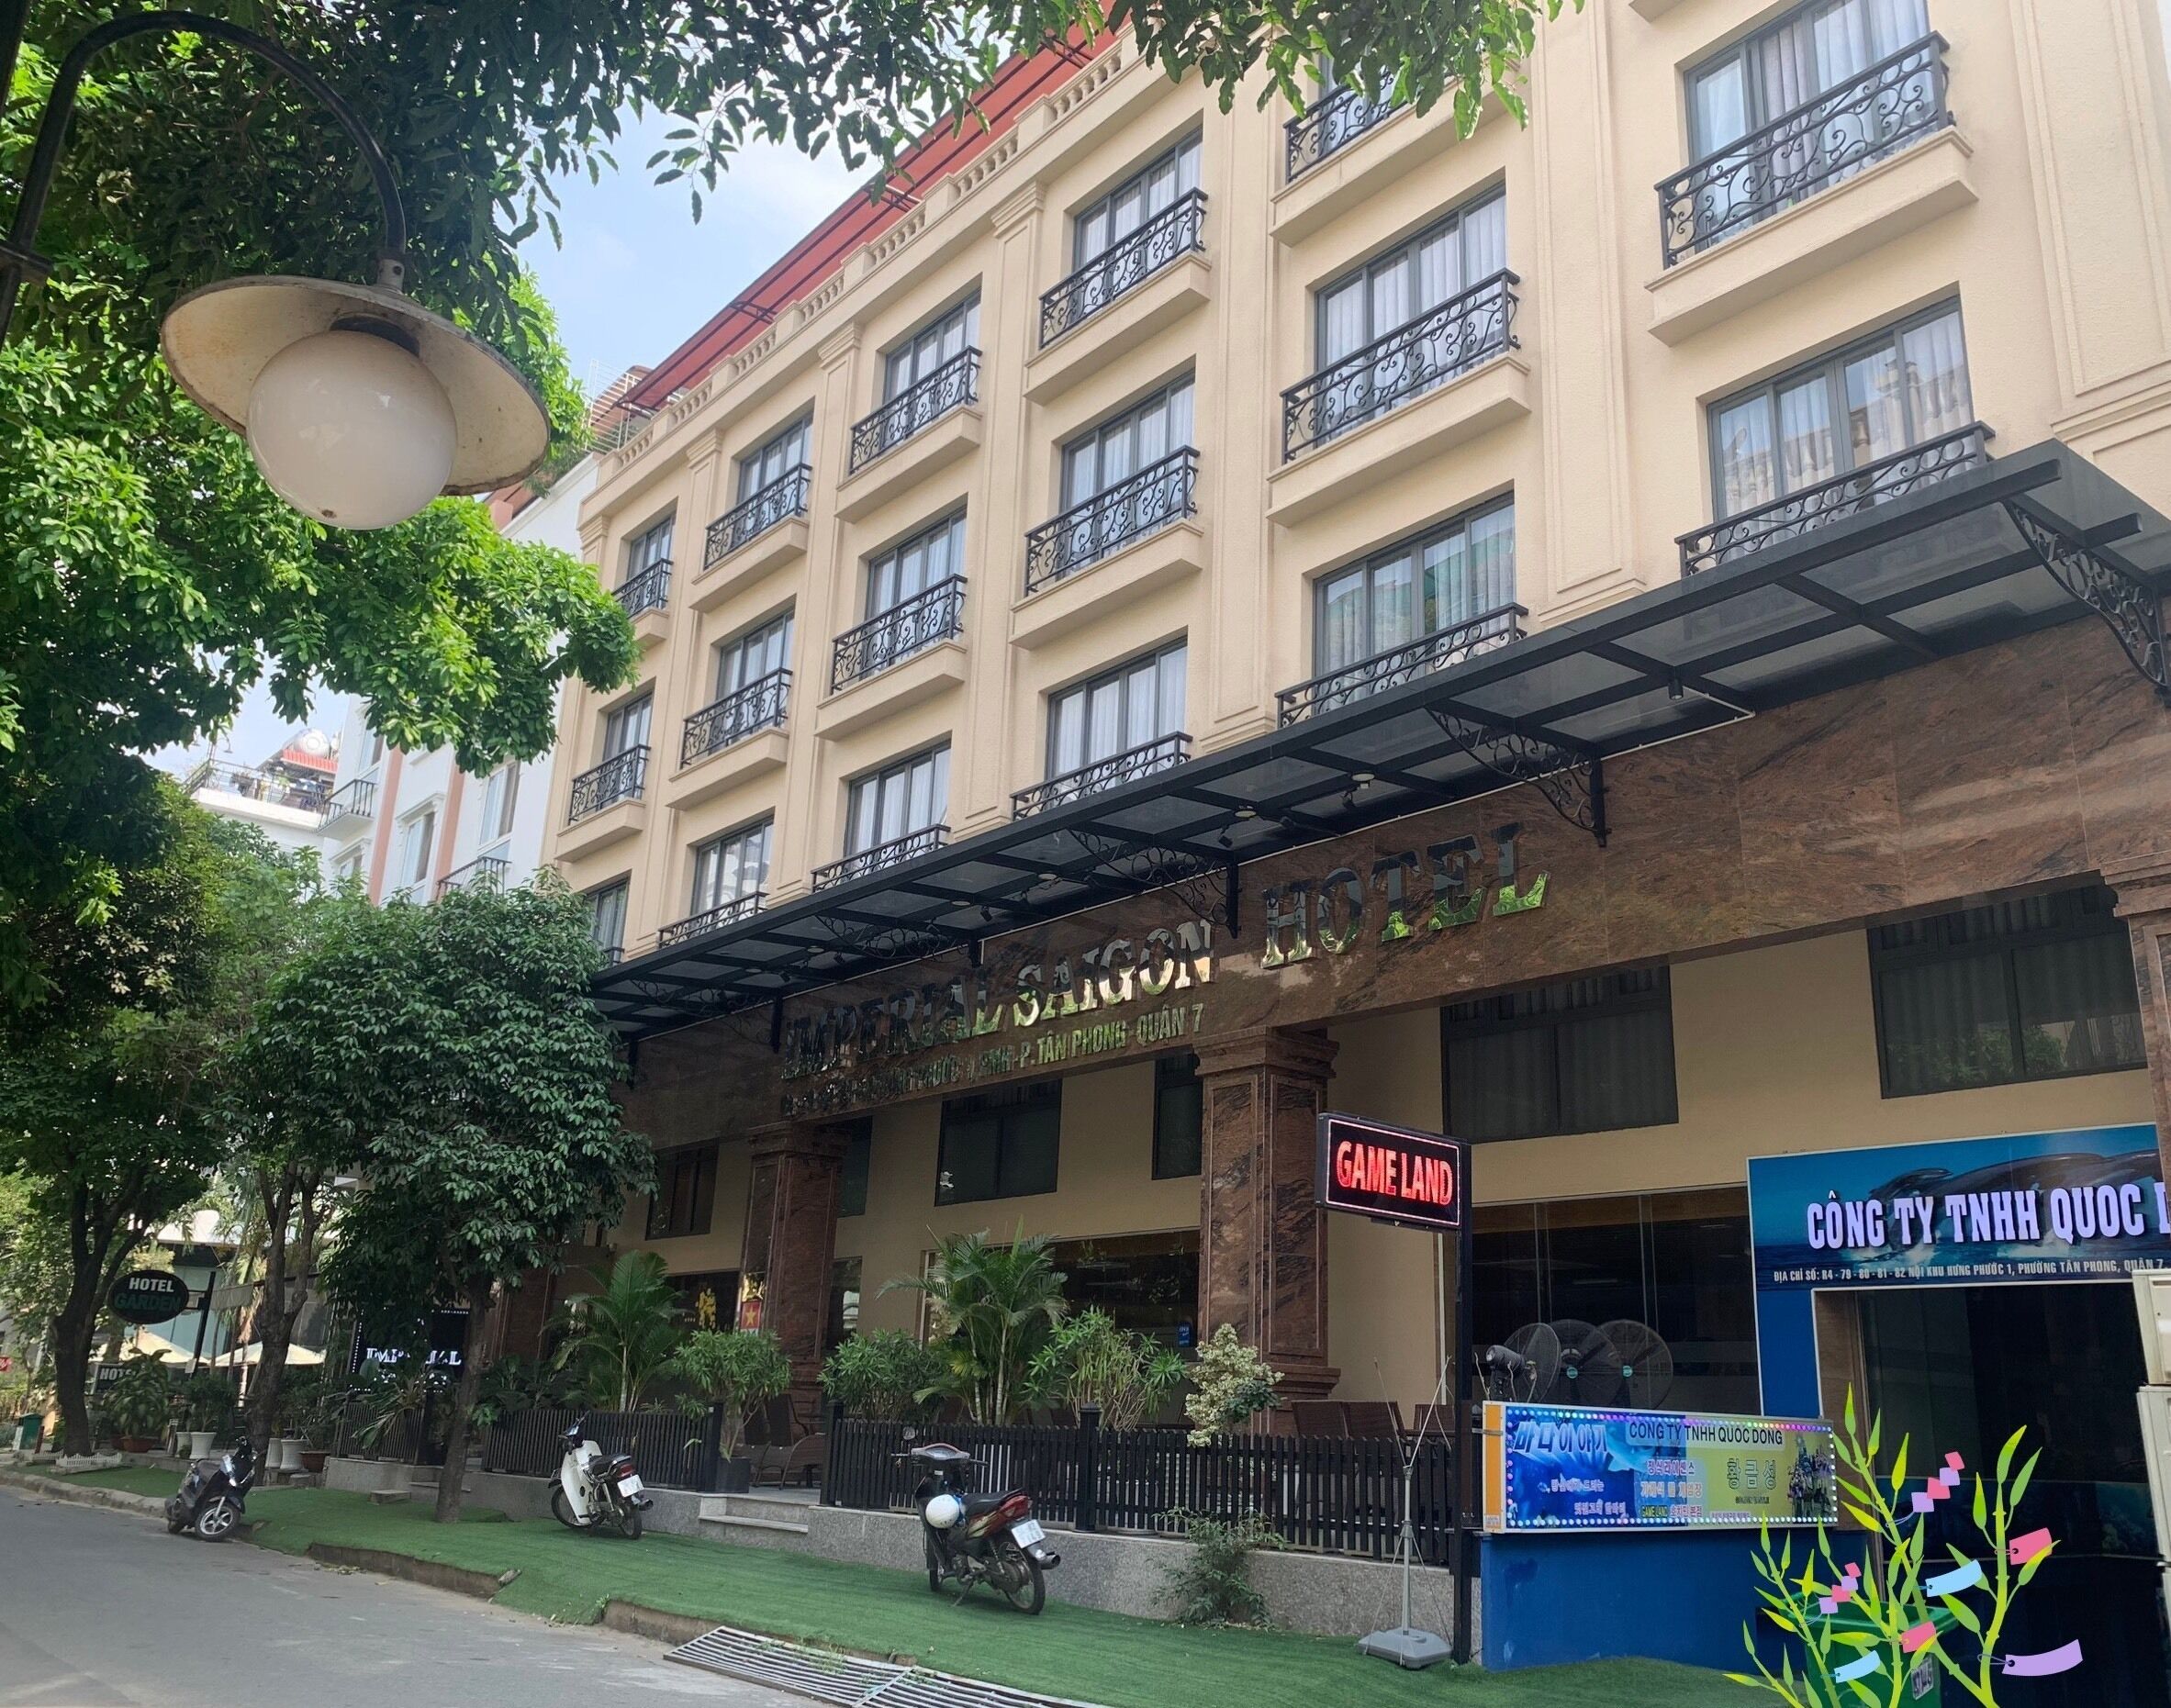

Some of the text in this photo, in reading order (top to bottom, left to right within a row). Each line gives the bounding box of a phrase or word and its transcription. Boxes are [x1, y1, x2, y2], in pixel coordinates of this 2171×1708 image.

[781, 821, 1550, 1080] IMPERIAL SAIGON HOTEL
[1071, 1019, 1126, 1058] PHONG
[1192, 1003, 1204, 1033] 7
[1337, 1141, 1453, 1207] GAME LAND
[1807, 1189, 1885, 1250] CÔNG
[1894, 1195, 1935, 1246] TY
[1945, 1189, 2041, 1244] TNHH
[2050, 1183, 2144, 1245] QUOC
[129, 1277, 174, 1292] HOTEL
[1774, 1271, 1788, 1284] ĐỊA
[1789, 1269, 1804, 1282] CHỈ
[1806, 1267, 1820, 1282] SỐ:
[1821, 1269, 1833, 1281] R4
[1841, 1269, 1852, 1280] 79
[1927, 1266, 1944, 1277] KHU
[1947, 1264, 1971, 1277] HƯNG
[1973, 1263, 2005, 1276] PHƯỚC
[2018, 1261, 2057, 1275] PHƯỜNG
[2059, 1260, 2081, 1274] TÂN
[2083, 1260, 2121, 1274] PHONG,
[114, 1292, 182, 1311] GARDEN
[1629, 1422, 1784, 1445] CONG TY TNHH QUOC DONG
